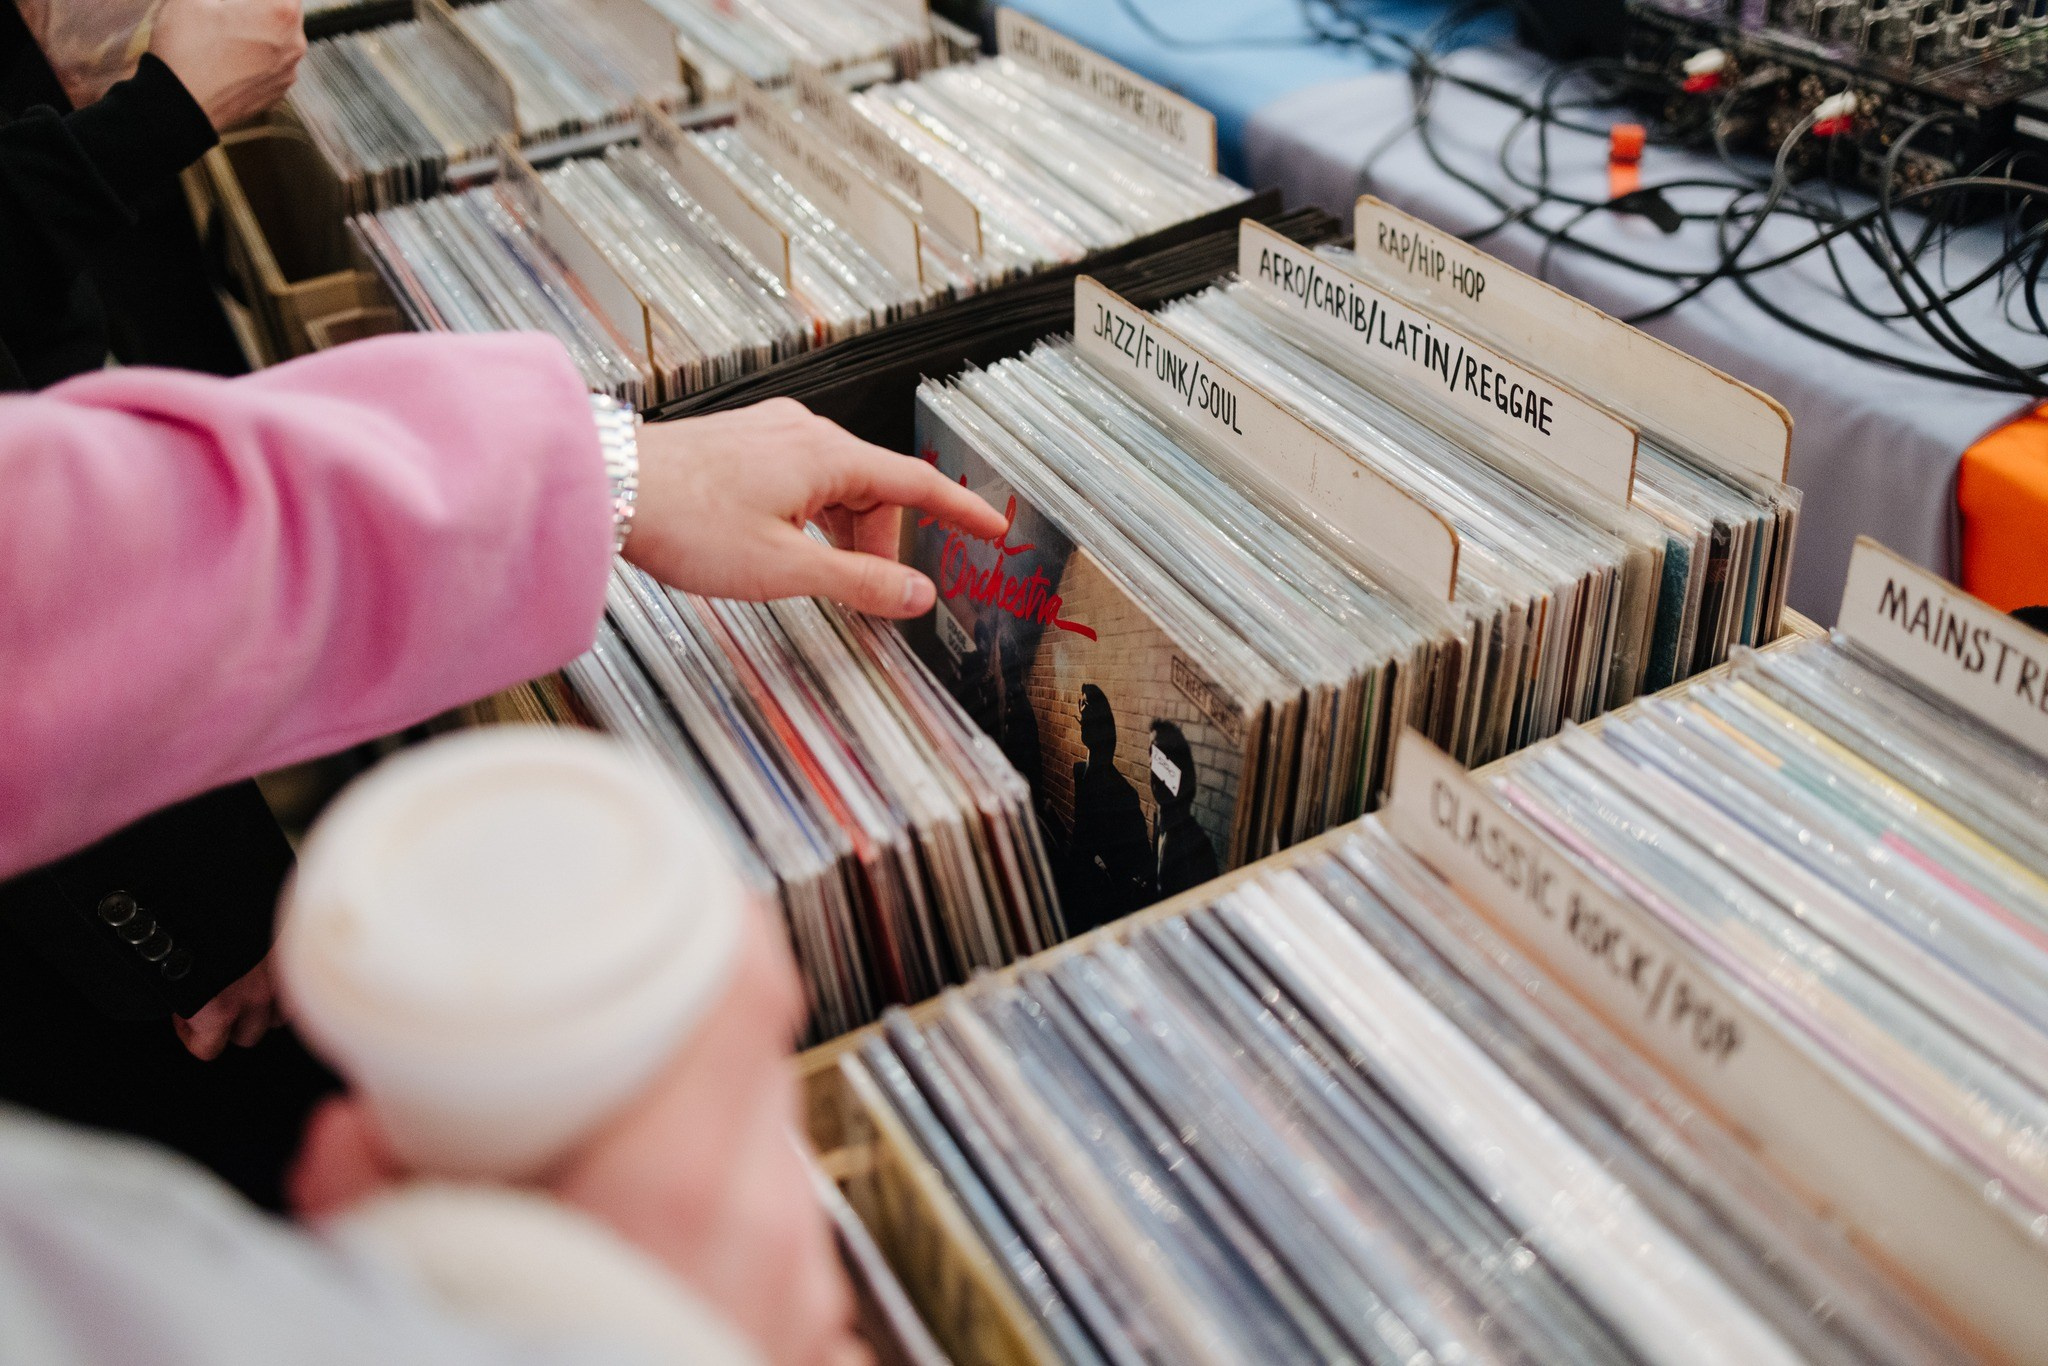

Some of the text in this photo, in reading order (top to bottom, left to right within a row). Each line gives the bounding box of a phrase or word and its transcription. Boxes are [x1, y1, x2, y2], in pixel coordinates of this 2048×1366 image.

[1093, 303, 1243, 436] JAZZ/FUNK/SOUL
[940, 531, 1098, 643] Orchestra
[1431, 777, 1743, 1066] CLASSIC ROCK/POP
